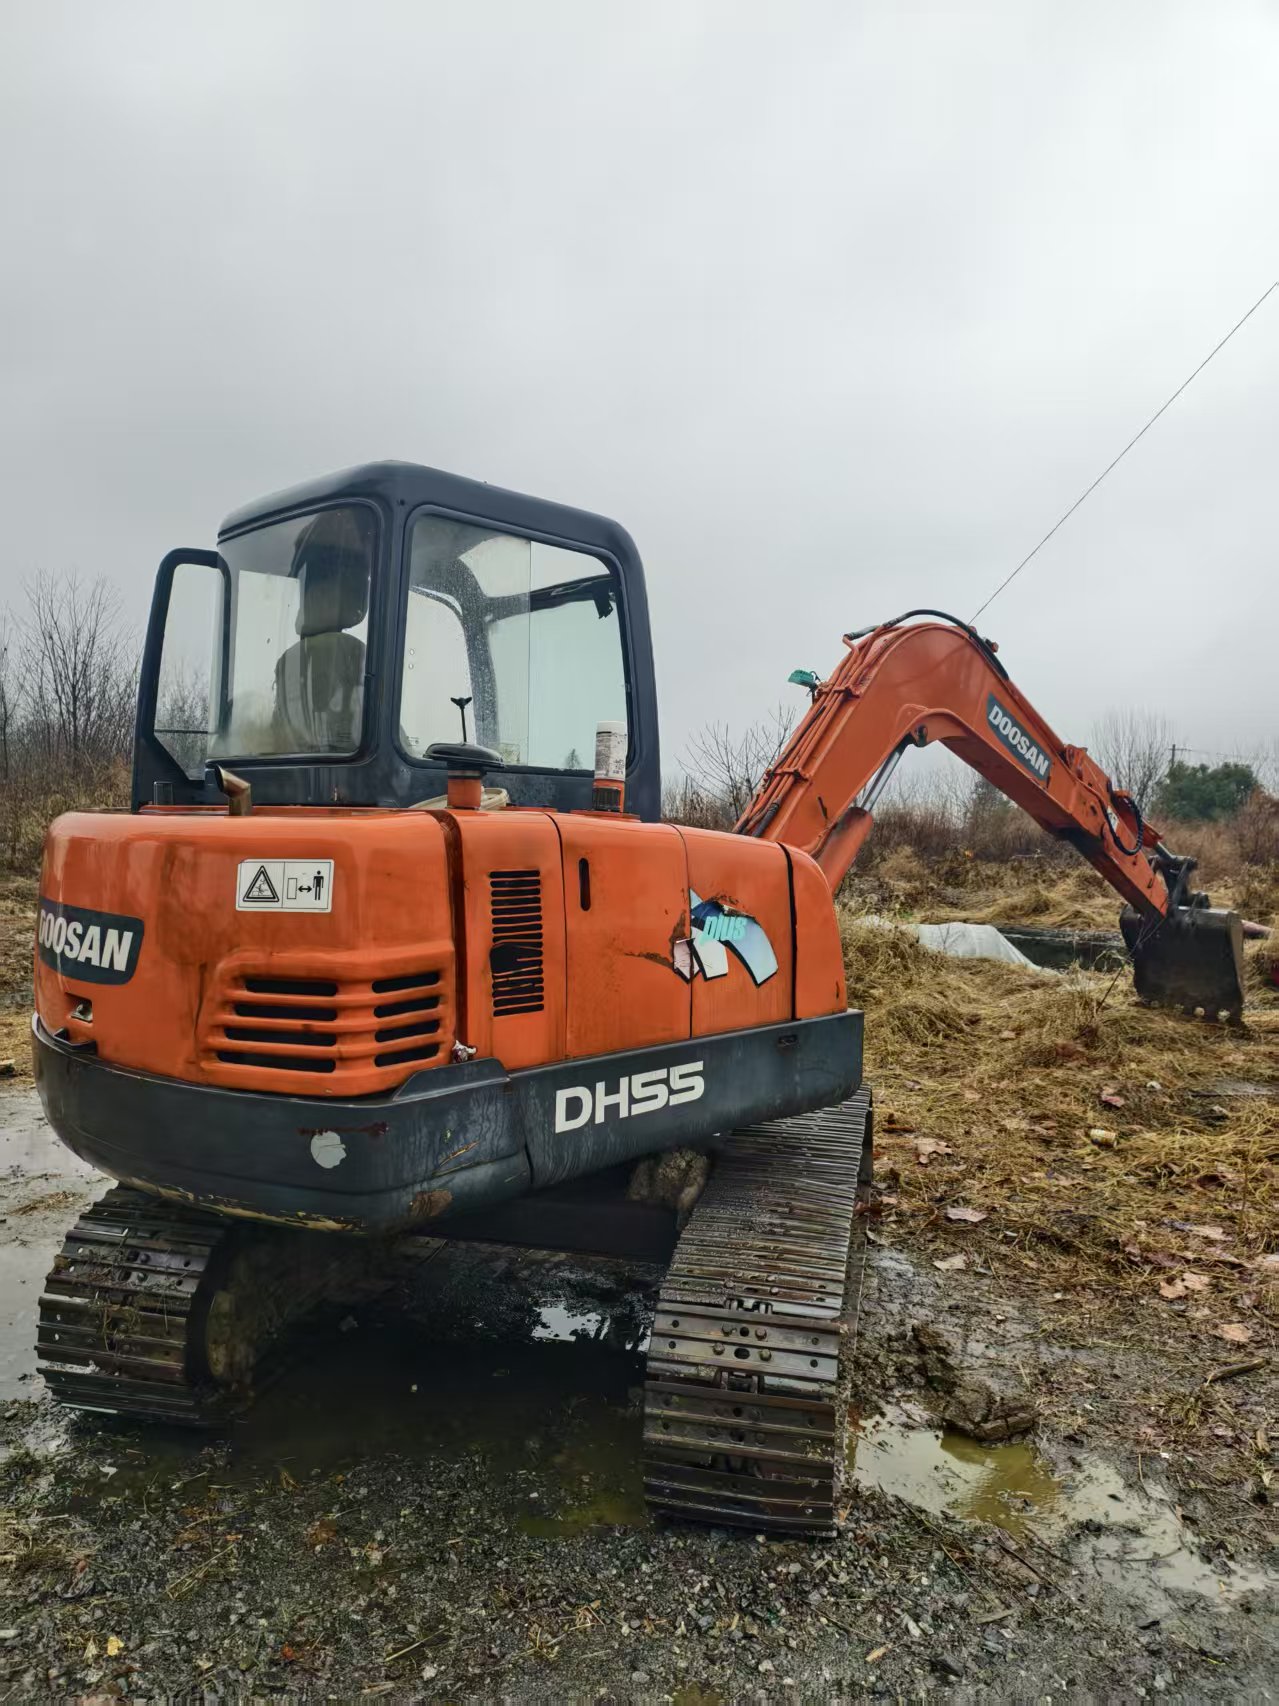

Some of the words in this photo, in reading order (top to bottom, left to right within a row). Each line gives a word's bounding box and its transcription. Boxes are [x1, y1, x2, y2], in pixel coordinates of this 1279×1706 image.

[988, 705, 1049, 776] DOOSAN
[699, 912, 747, 946] plus
[555, 1060, 705, 1134] DH55
